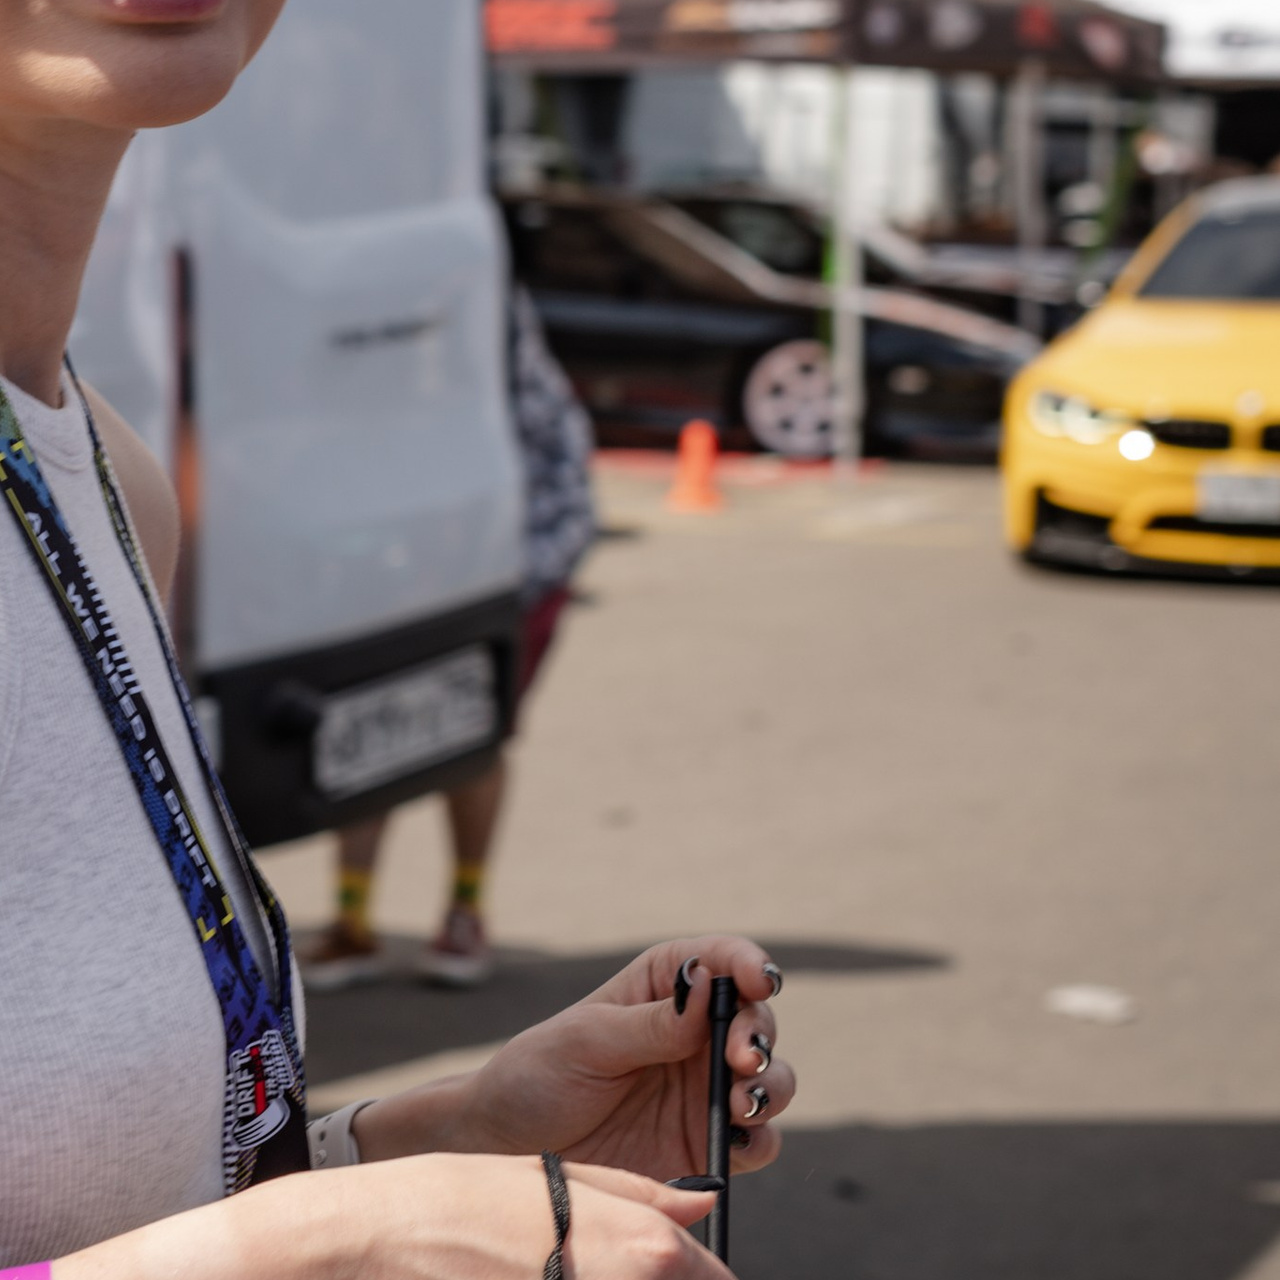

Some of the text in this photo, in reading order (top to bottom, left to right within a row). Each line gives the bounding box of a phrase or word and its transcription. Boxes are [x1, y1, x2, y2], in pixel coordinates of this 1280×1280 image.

[25, 511, 218, 888] ALL WE NEED IS DRIFT
[235, 1051, 256, 1119] DRIFT
